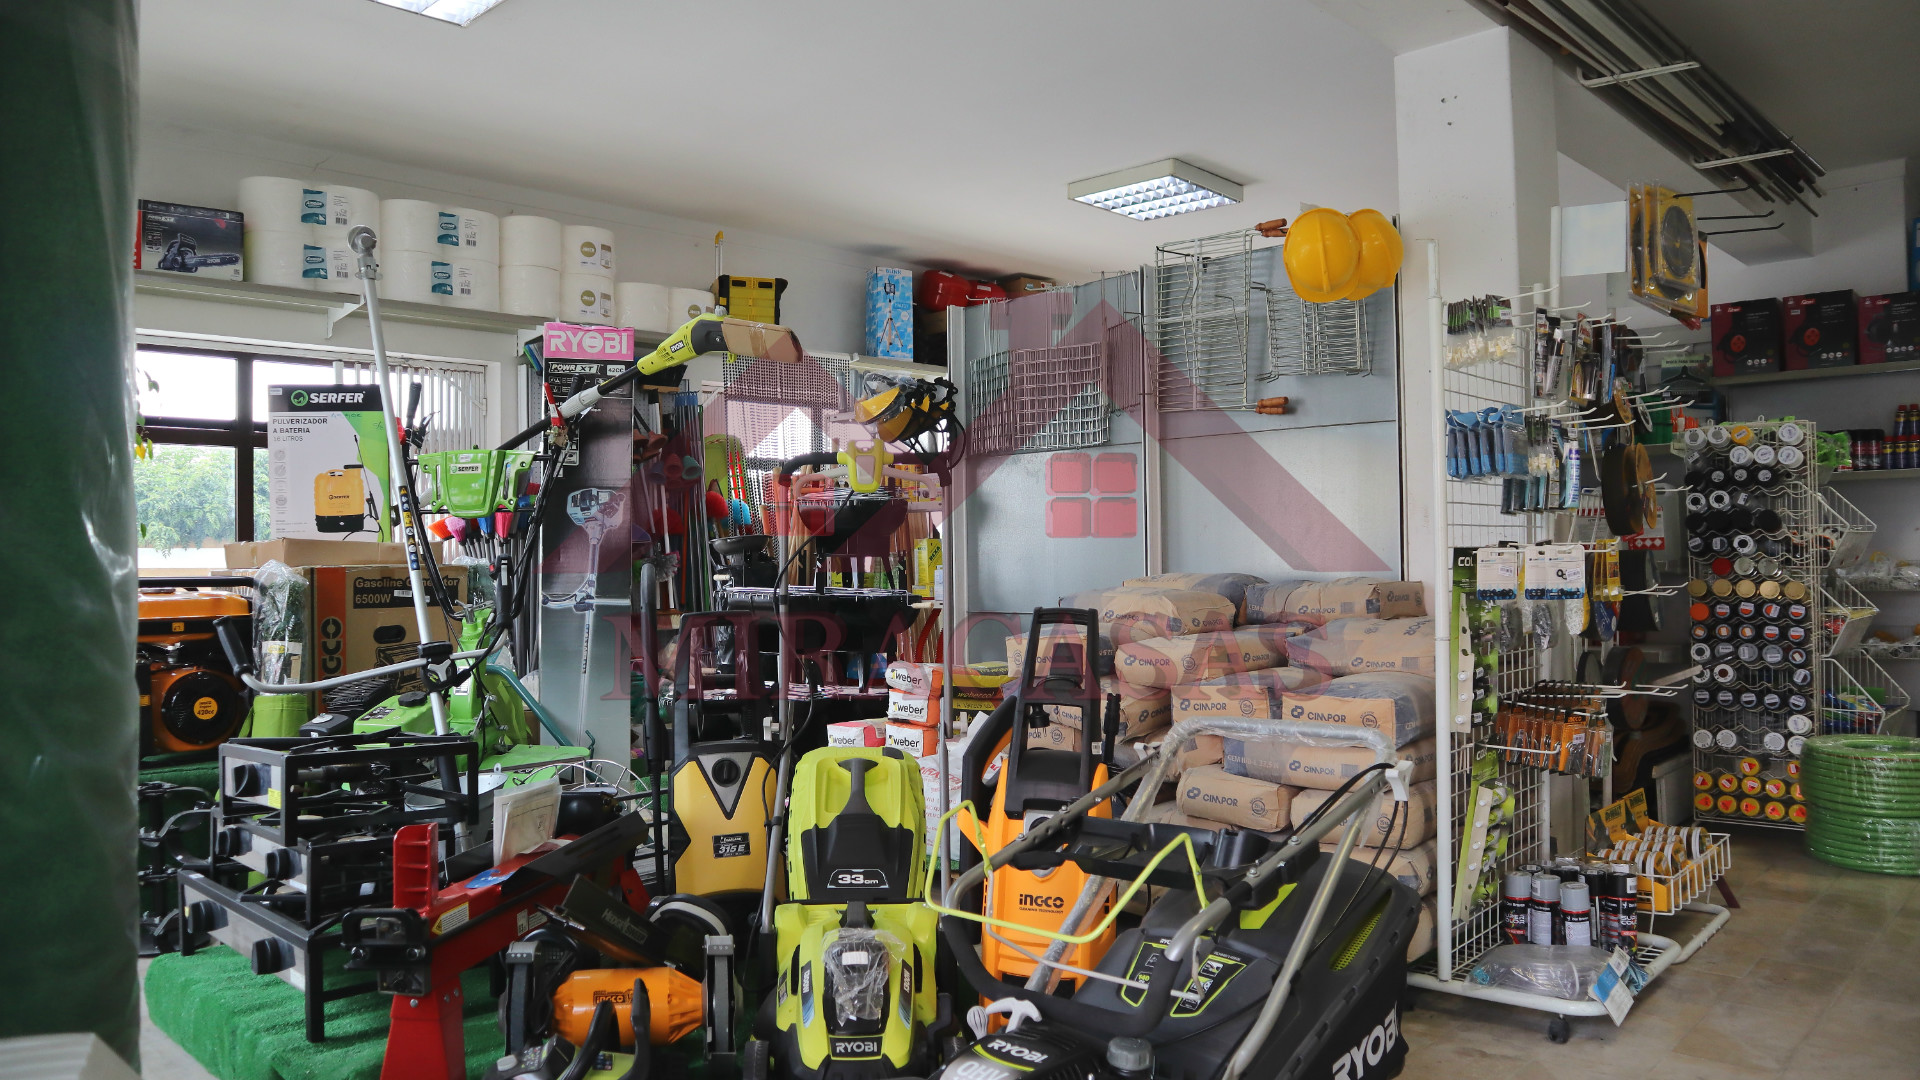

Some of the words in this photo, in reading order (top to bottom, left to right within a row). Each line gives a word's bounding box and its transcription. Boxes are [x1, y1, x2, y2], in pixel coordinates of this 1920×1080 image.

[547, 330, 628, 355] RYOBI
[551, 363, 576, 372] POWR
[309, 392, 364, 404] SERFER
[355, 577, 403, 588] Gasoline
[355, 593, 391, 604] 6500W
[1138, 657, 1171, 667] CIMPOR
[1365, 660, 1396, 669] CIMPOR
[894, 672, 922, 686] weber
[897, 702, 925, 715] weber
[1193, 702, 1227, 711] CIMPOR
[1307, 711, 1347, 723] CIMPOR
[833, 735, 856, 745] weber
[893, 735, 920, 748] weber
[1303, 766, 1336, 776] CIMPOR
[1202, 794, 1239, 807] CIMPOR
[835, 1042, 878, 1054] RYOBI
[987, 1039, 1048, 1063] RYOBI
